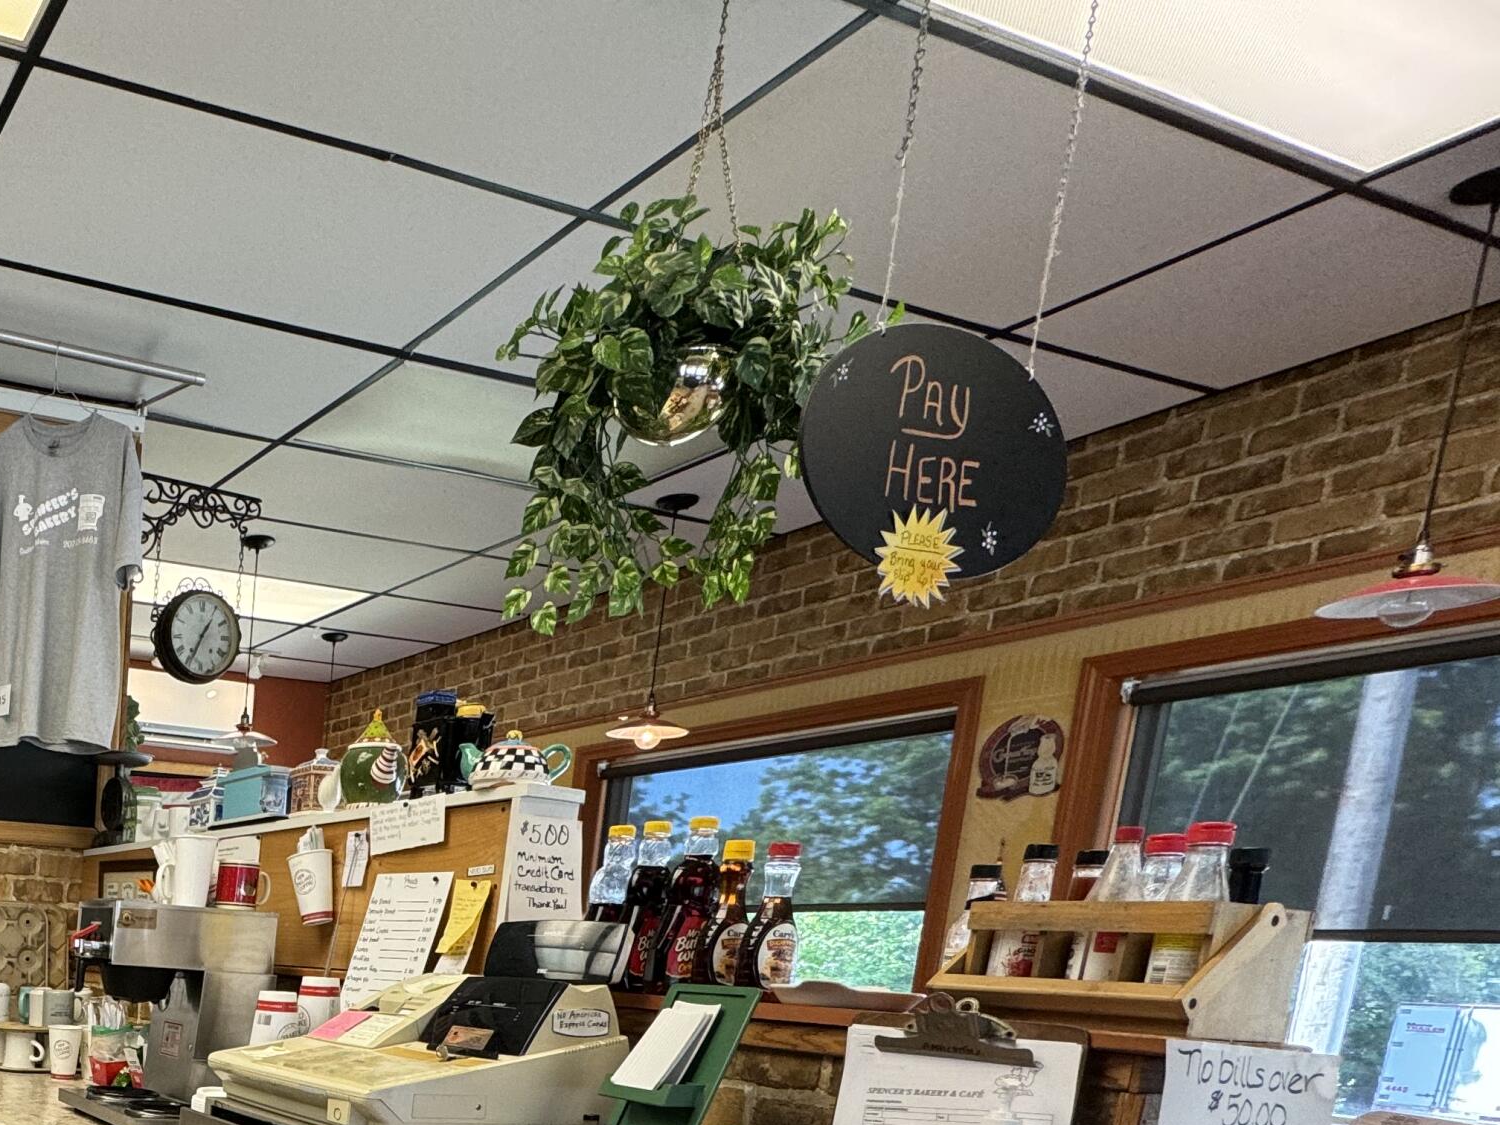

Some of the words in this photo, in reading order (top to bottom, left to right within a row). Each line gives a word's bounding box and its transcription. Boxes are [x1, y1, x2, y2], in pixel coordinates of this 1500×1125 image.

[885, 440, 981, 514] HERE
[901, 530, 940, 548] PLEASE
[890, 552, 916, 571] Bring
[920, 560, 942, 577] your
[520, 821, 570, 846] $5.00
[517, 864, 548, 880] Credit
[550, 867, 575, 881] Card
[528, 897, 548, 909] Thank
[559, 1020, 586, 1030] Express
[1178, 1048, 1214, 1084] No
[1218, 1051, 1265, 1089] bills
[1268, 1065, 1326, 1095] over
[867, 1087, 913, 1096] SPENCER'S
[914, 1089, 948, 1097] BAKERY
